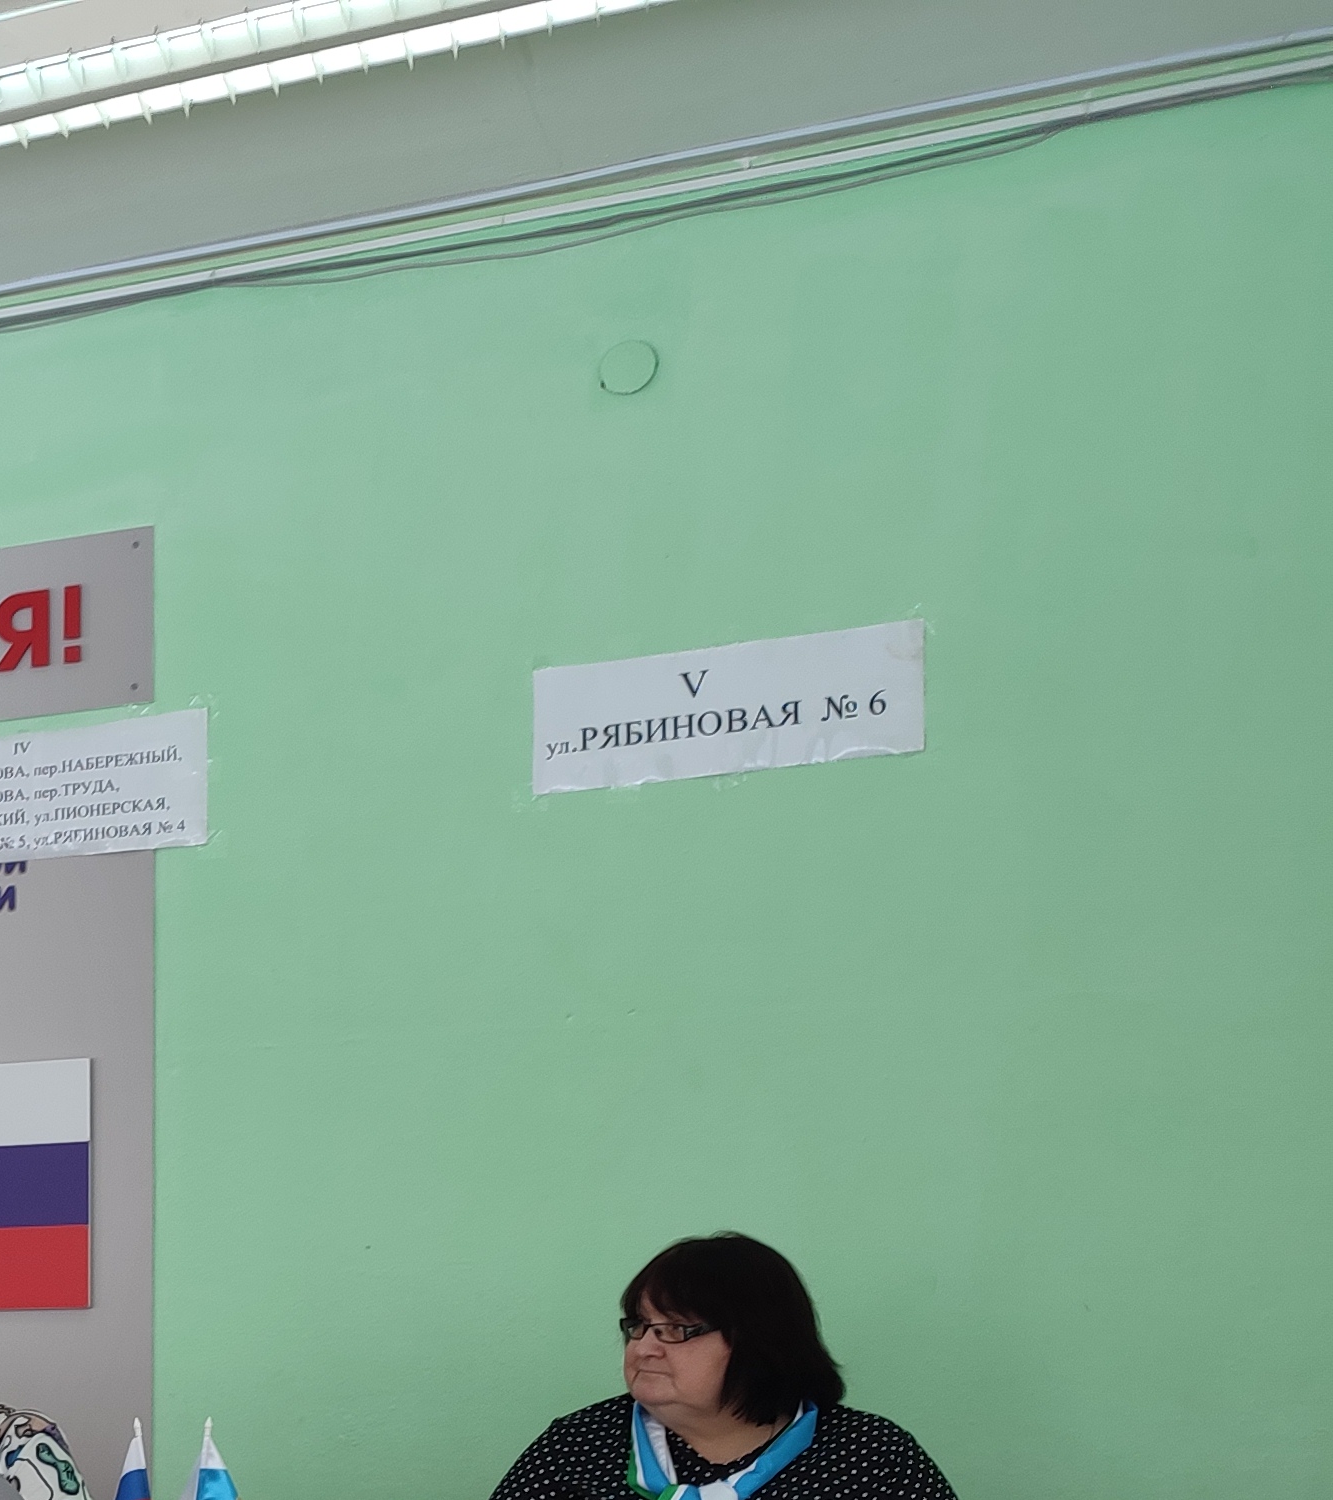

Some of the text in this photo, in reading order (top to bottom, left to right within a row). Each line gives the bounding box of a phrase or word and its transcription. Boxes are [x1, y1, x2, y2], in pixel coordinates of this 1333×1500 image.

[678, 669, 709, 698] V
[545, 689, 887, 761] ул.РЯБИНОВАЯ № 6
[13, 741, 31, 755] IV
[33, 745, 183, 778] пер.НАБЕРЕЖНЫЙ,
[34, 779, 120, 802] пер.ТРУДА,
[34, 797, 171, 827] ул.ПИОНЕРСКАЯ,
[18, 834, 31, 849] 5,
[156, 820, 173, 835] №
[176, 819, 186, 832] 4
